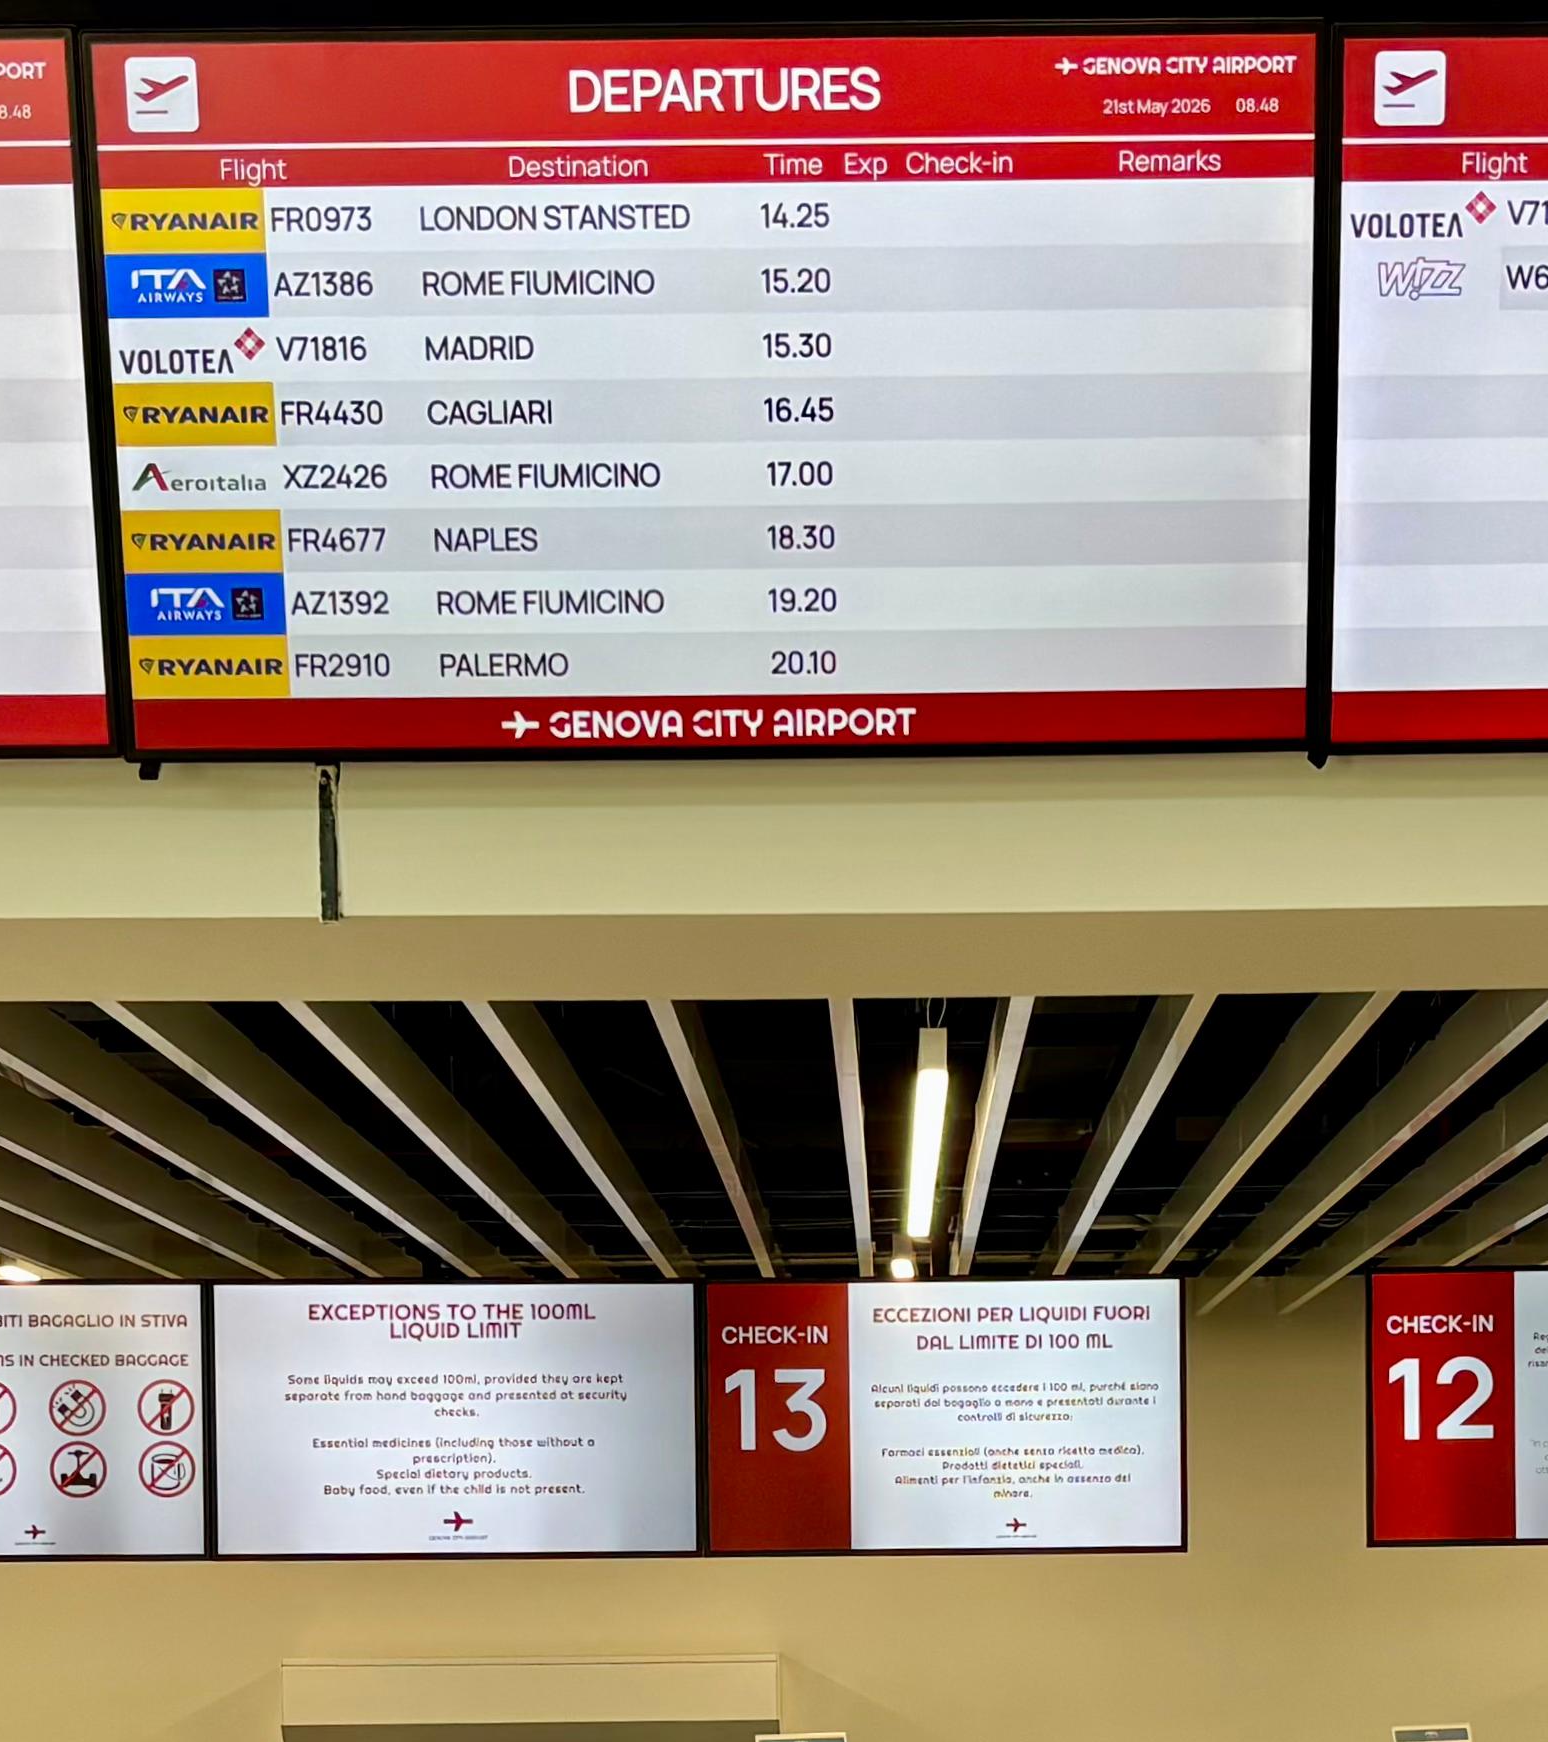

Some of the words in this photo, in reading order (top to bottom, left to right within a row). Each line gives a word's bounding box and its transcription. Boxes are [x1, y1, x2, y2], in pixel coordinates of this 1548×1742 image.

[569, 67, 880, 112] DEPARTURES
[131, 213, 258, 230] RYANAIR
[271, 206, 371, 232] FR0973
[420, 206, 536, 231] LONDON
[544, 205, 690, 230] STANSTED
[761, 203, 829, 228] 14.25
[1351, 213, 1463, 238] VOLOTEA
[131, 269, 206, 289] ITA
[274, 271, 373, 296] AZ1386
[423, 271, 504, 296] ROME
[511, 270, 654, 295] FIUMICINO
[762, 268, 830, 293] 15.20
[137, 292, 203, 304] AIRWAYS
[120, 349, 233, 374] VOLOTEA
[276, 336, 366, 361] V71816
[426, 336, 533, 360] MADRID
[763, 333, 831, 358] 15.30
[281, 400, 382, 425] FR4430
[428, 400, 552, 425] CAGLIARI
[764, 397, 833, 422] 16.45
[133, 463, 266, 491] Aeroitalia
[284, 464, 387, 489] XZ2426
[431, 464, 511, 488] ROME
[519, 463, 660, 488] FIUMICINO
[767, 461, 832, 486] 17.00
[288, 528, 385, 552] FR4677
[435, 528, 537, 551] NAPLES
[768, 525, 834, 549] 18.30
[292, 591, 389, 615] AZ1392
[438, 591, 516, 614] ROME
[524, 590, 664, 614] FIUMICINO
[769, 588, 836, 612] 19.20
[295, 653, 389, 677] FR2910
[440, 653, 568, 677] PALERMO
[772, 651, 836, 674] 20.10
[29, 1315, 113, 1327] BAGAGLIO
[120, 1315, 135, 1327] IN
[141, 1315, 187, 1327] STIVA
[309, 1304, 440, 1320] EXCEPTIONS
[447, 1304, 476, 1320] TO
[483, 1304, 523, 1319] THE
[873, 1308, 970, 1323] ECCEZIONI
[978, 1307, 1013, 1322] PER
[1020, 1307, 1086, 1324] LIQUIDI
[1094, 1306, 1149, 1320] FUORI
[1387, 1315, 1493, 1334] CHECK-IN
[391, 1323, 459, 1341] LIQUID
[468, 1322, 521, 1338] LIMIT
[722, 1326, 828, 1344] CHECK-IN
[917, 1336, 953, 1350] DAL
[960, 1335, 1018, 1349] LIMITE
[1025, 1334, 1044, 1350] DI
[1049, 1334, 1079, 1349] 100
[19, 1354, 34, 1367] IN
[39, 1354, 109, 1366] CHECKED
[115, 1354, 188, 1366] BAGGAGE
[725, 1369, 826, 1451] 13
[1389, 1356, 1493, 1440] 12
[377, 1469, 420, 1480] Special
